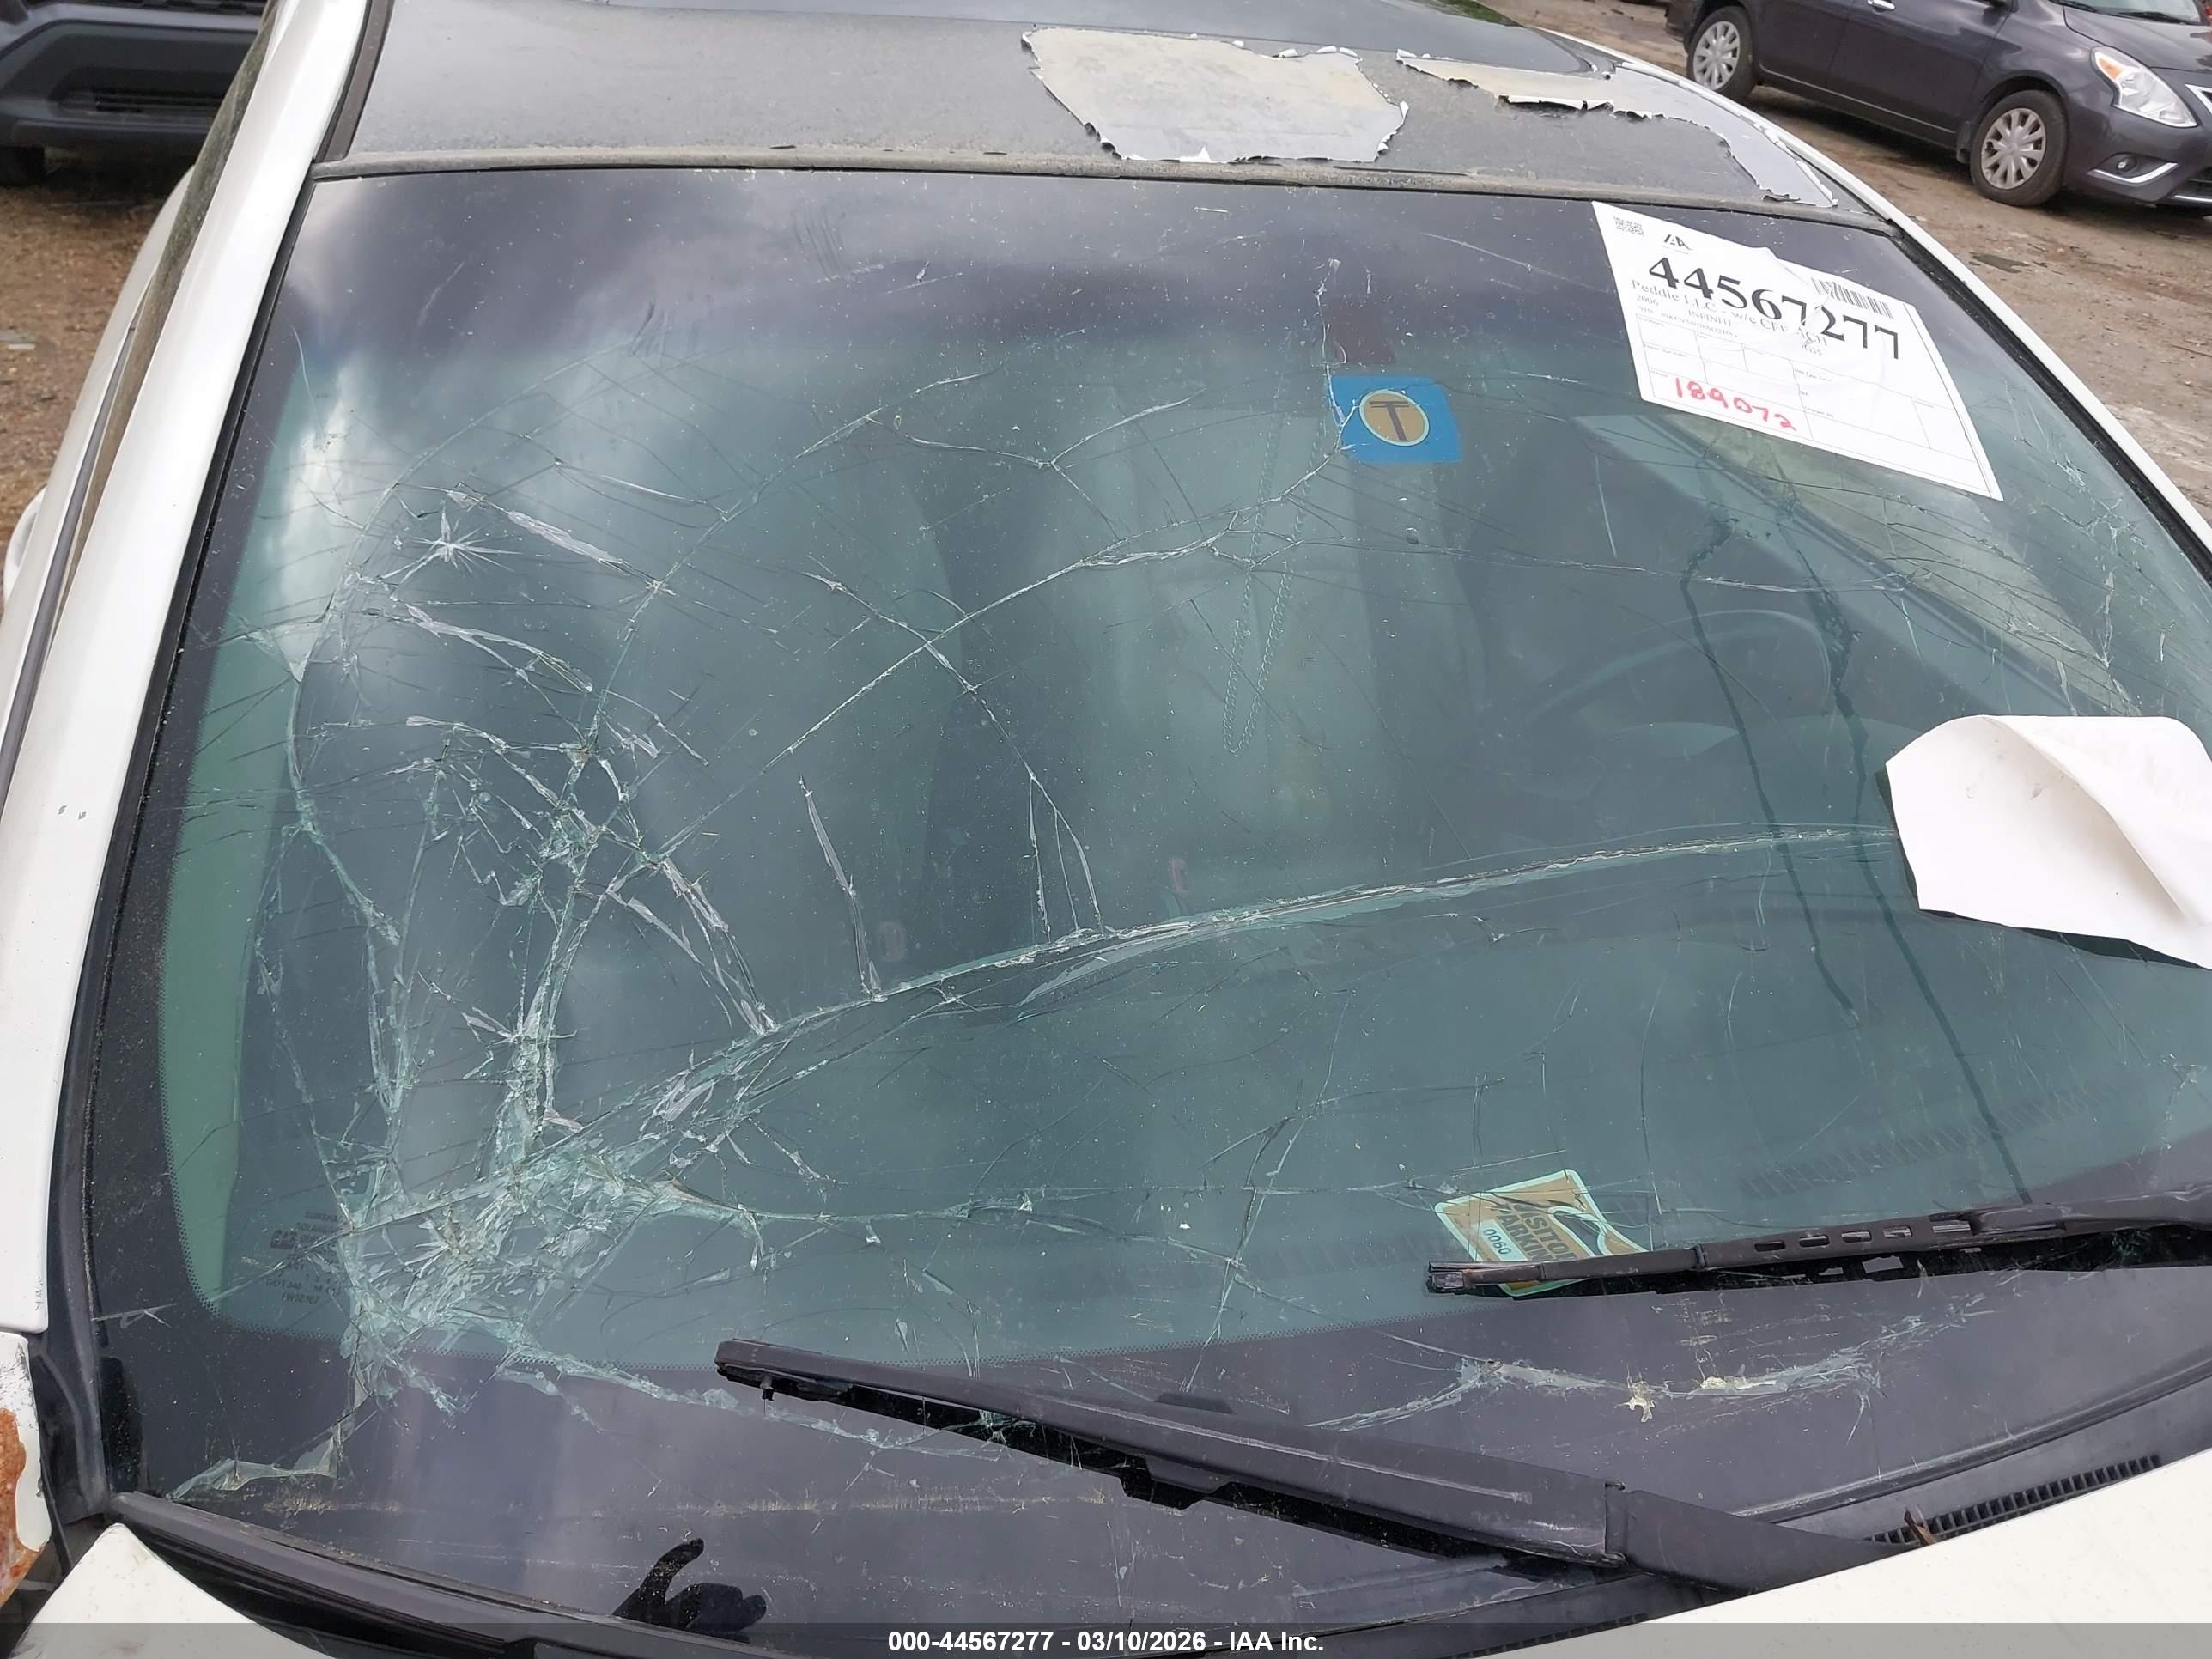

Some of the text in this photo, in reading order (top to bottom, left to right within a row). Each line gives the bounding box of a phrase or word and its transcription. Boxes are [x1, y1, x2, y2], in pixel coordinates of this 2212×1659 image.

[1632, 279, 1680, 301] Peddle
[1649, 257, 1899, 360] 44567277
[1675, 377, 1797, 431] 189072
[1483, 1229, 1511, 1255] 0060
[1495, 1202, 1554, 1261] PARKIN
